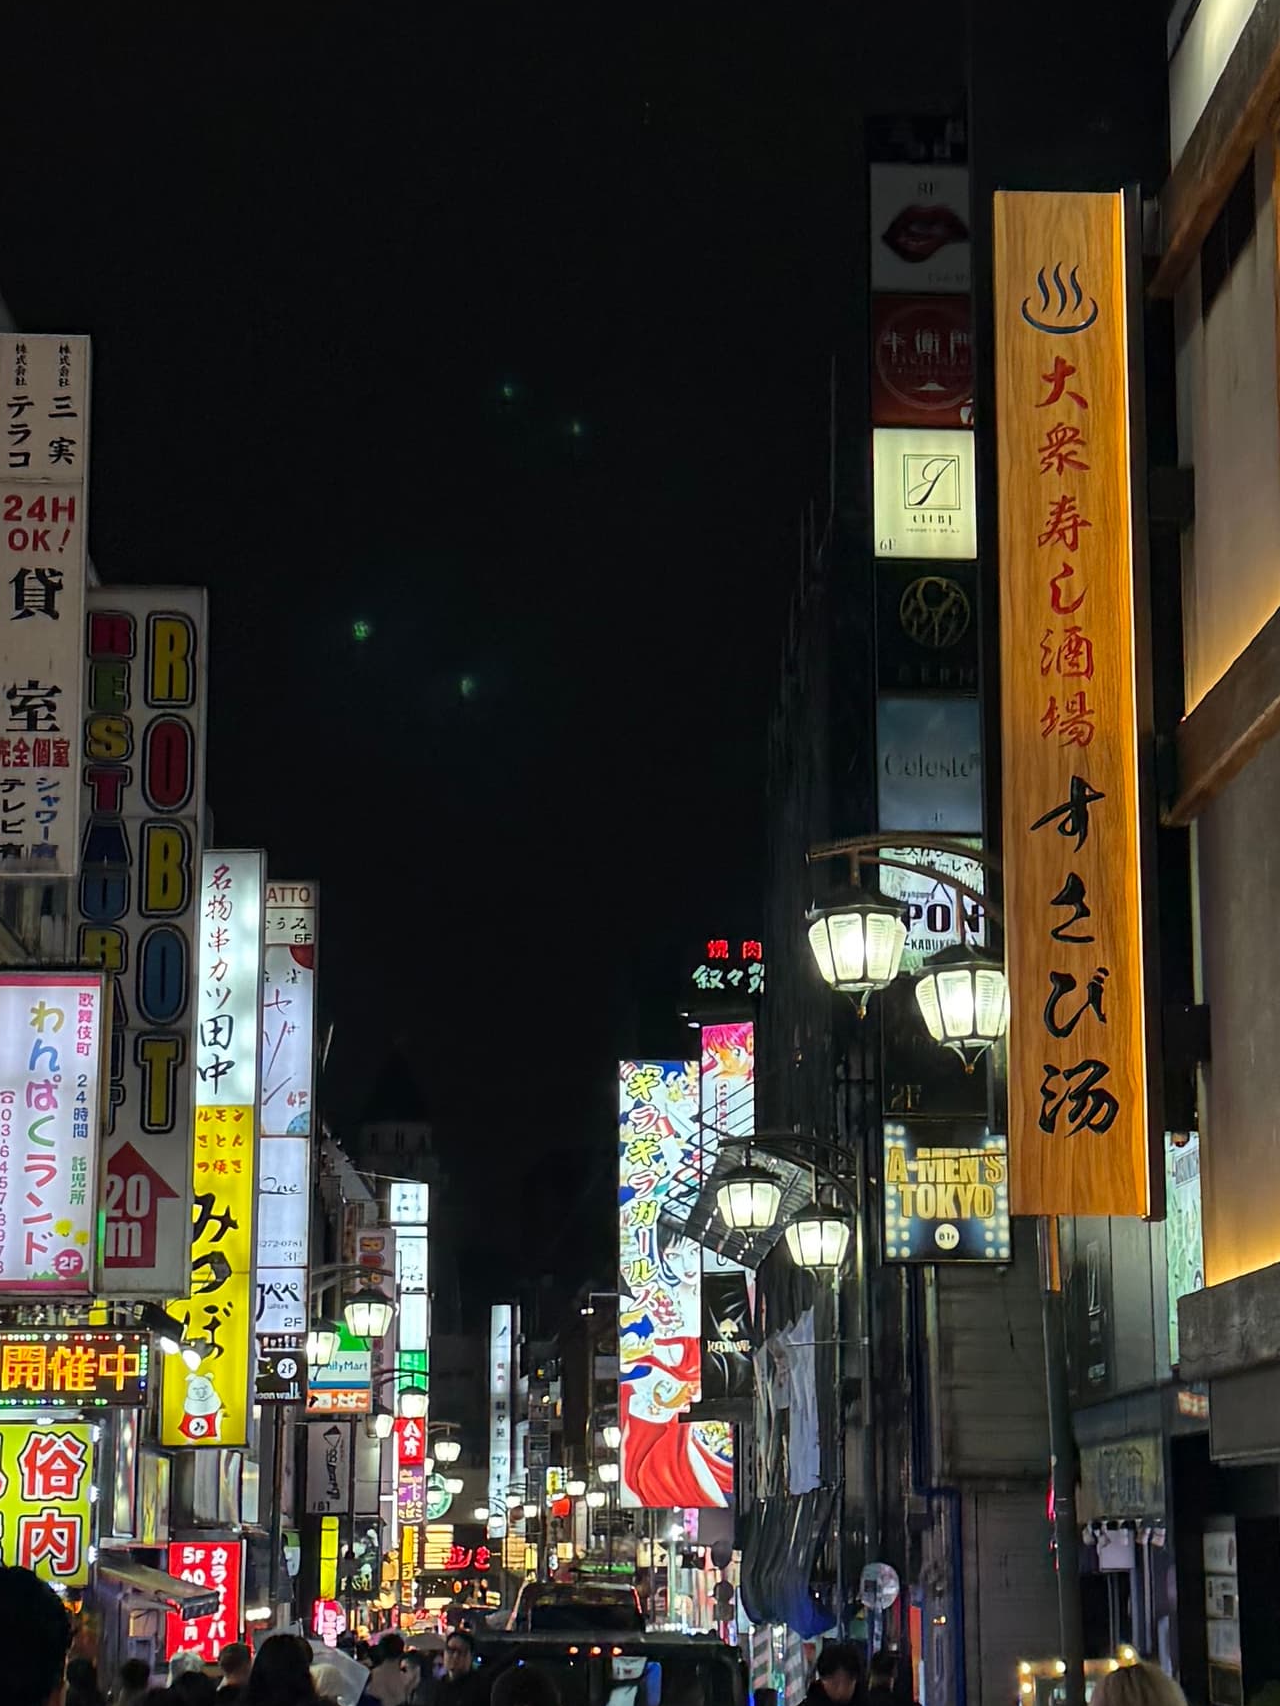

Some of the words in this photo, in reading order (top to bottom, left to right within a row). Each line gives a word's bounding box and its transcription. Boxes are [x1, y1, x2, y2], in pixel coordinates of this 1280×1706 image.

[7, 395, 35, 468] テラコ
[48, 395, 78, 465] 三実
[3, 494, 75, 523] 24H
[7, 529, 71, 556] OK!
[1036, 355, 1096, 747] 大衆寿し酒場
[135, 612, 197, 1135] ROBOT
[295, 934, 312, 943] 5F
[1028, 776, 1119, 1138] すさび湯
[77, 993, 95, 1057] 歌舞伎町
[71, 1074, 91, 1139] 24時間
[21, 1000, 66, 1269] わんぱくランド
[69, 1155, 88, 1206] 託児所
[898, 1183, 996, 1222] TOKYO
[57, 1254, 82, 1272] 2F
[284, 1317, 303, 1327] 2F
[280, 1363, 293, 1374] 2F
[183, 1547, 205, 1564] 5F
